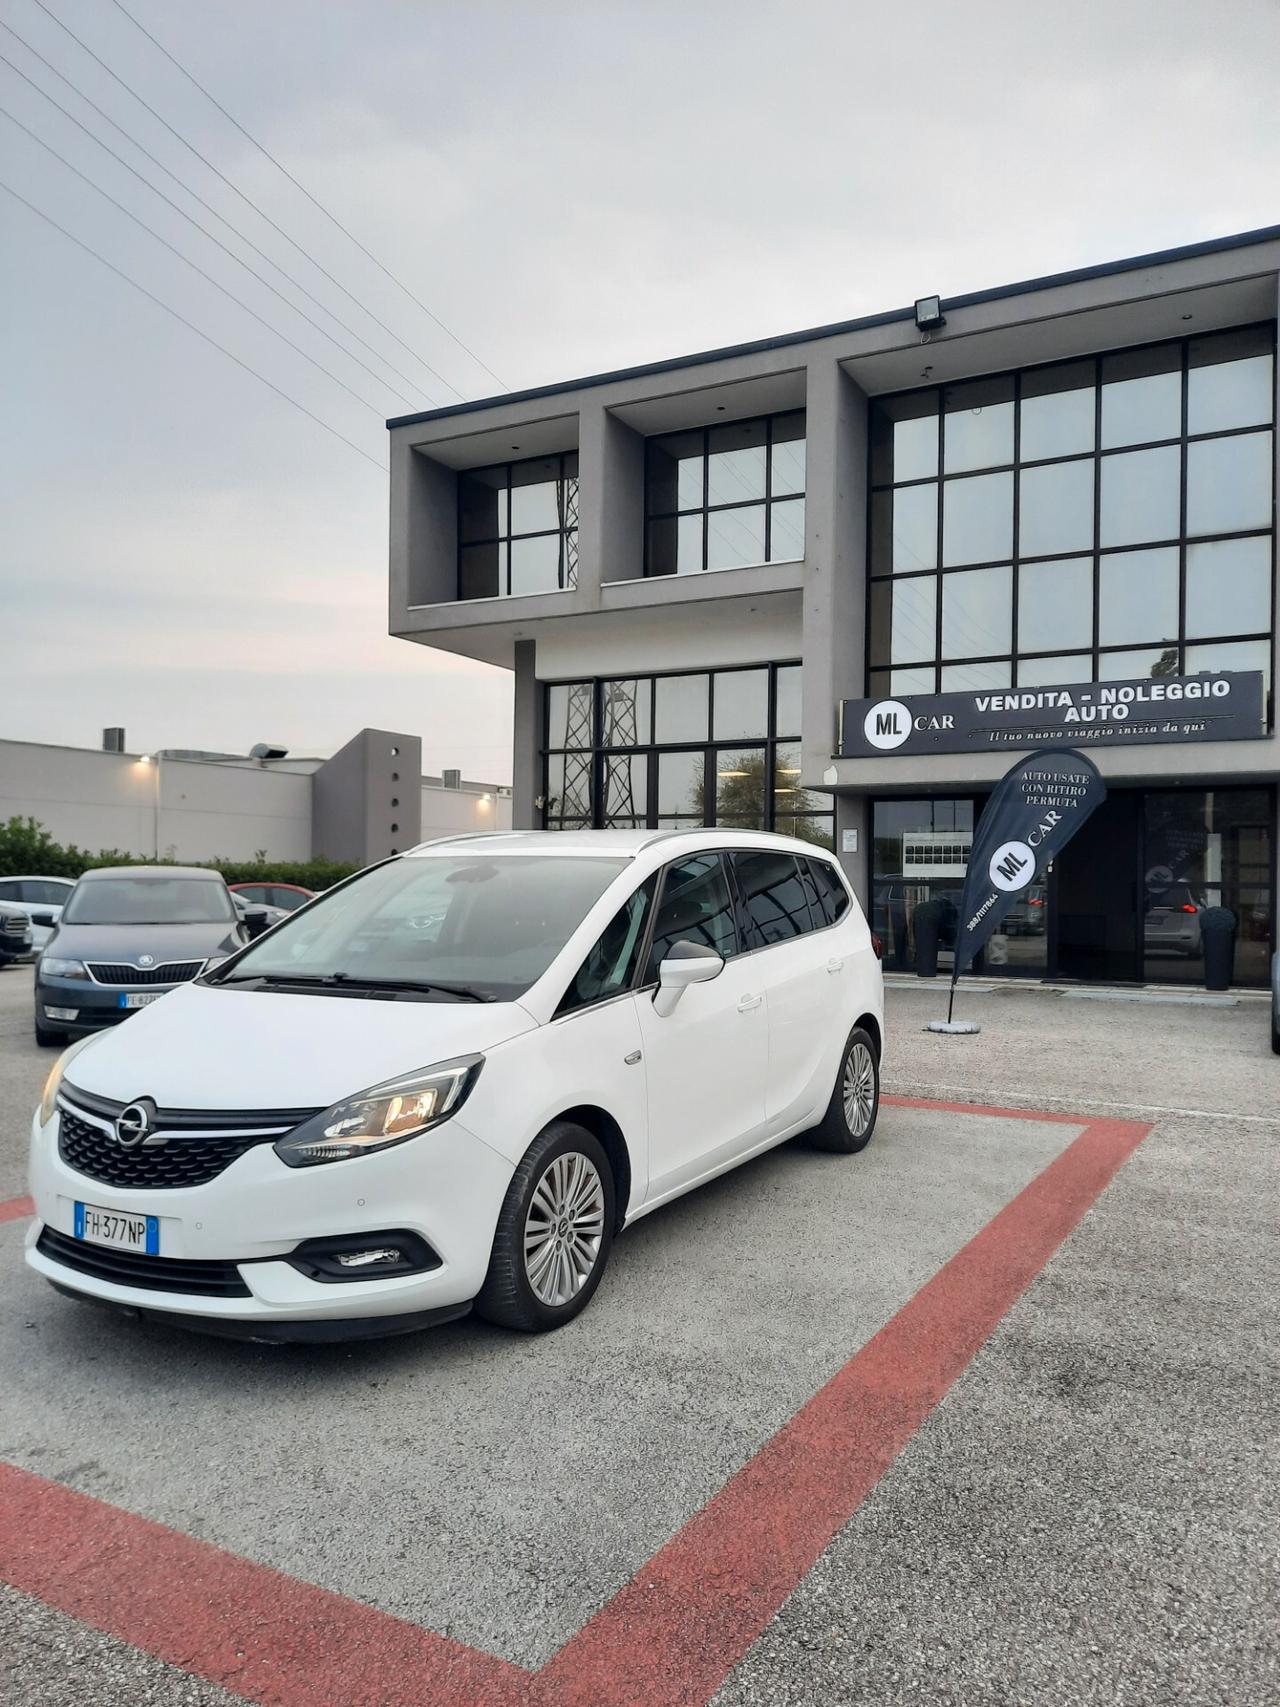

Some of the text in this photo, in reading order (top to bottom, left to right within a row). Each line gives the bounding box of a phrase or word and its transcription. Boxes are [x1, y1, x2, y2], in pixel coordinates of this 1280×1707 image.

[975, 691, 1074, 712] VENDITA
[1100, 680, 1231, 704] NOLEGGIO
[1064, 703, 1129, 722] AUTO
[876, 712, 955, 736] ML CAR
[1003, 732, 1023, 740] tuo
[1027, 731, 1063, 739] nuovo
[1067, 725, 1114, 739] viaggio
[1118, 723, 1157, 735] inizia
[1162, 722, 1178, 733] da
[1183, 720, 1206, 735] qui
[1021, 771, 1090, 784] AUTO USATE
[1021, 783, 1087, 796] CON RITIRO
[1026, 795, 1078, 808] PERMUTA
[996, 810, 1063, 882] ML CAR
[966, 893, 999, 932] 388/1117864
